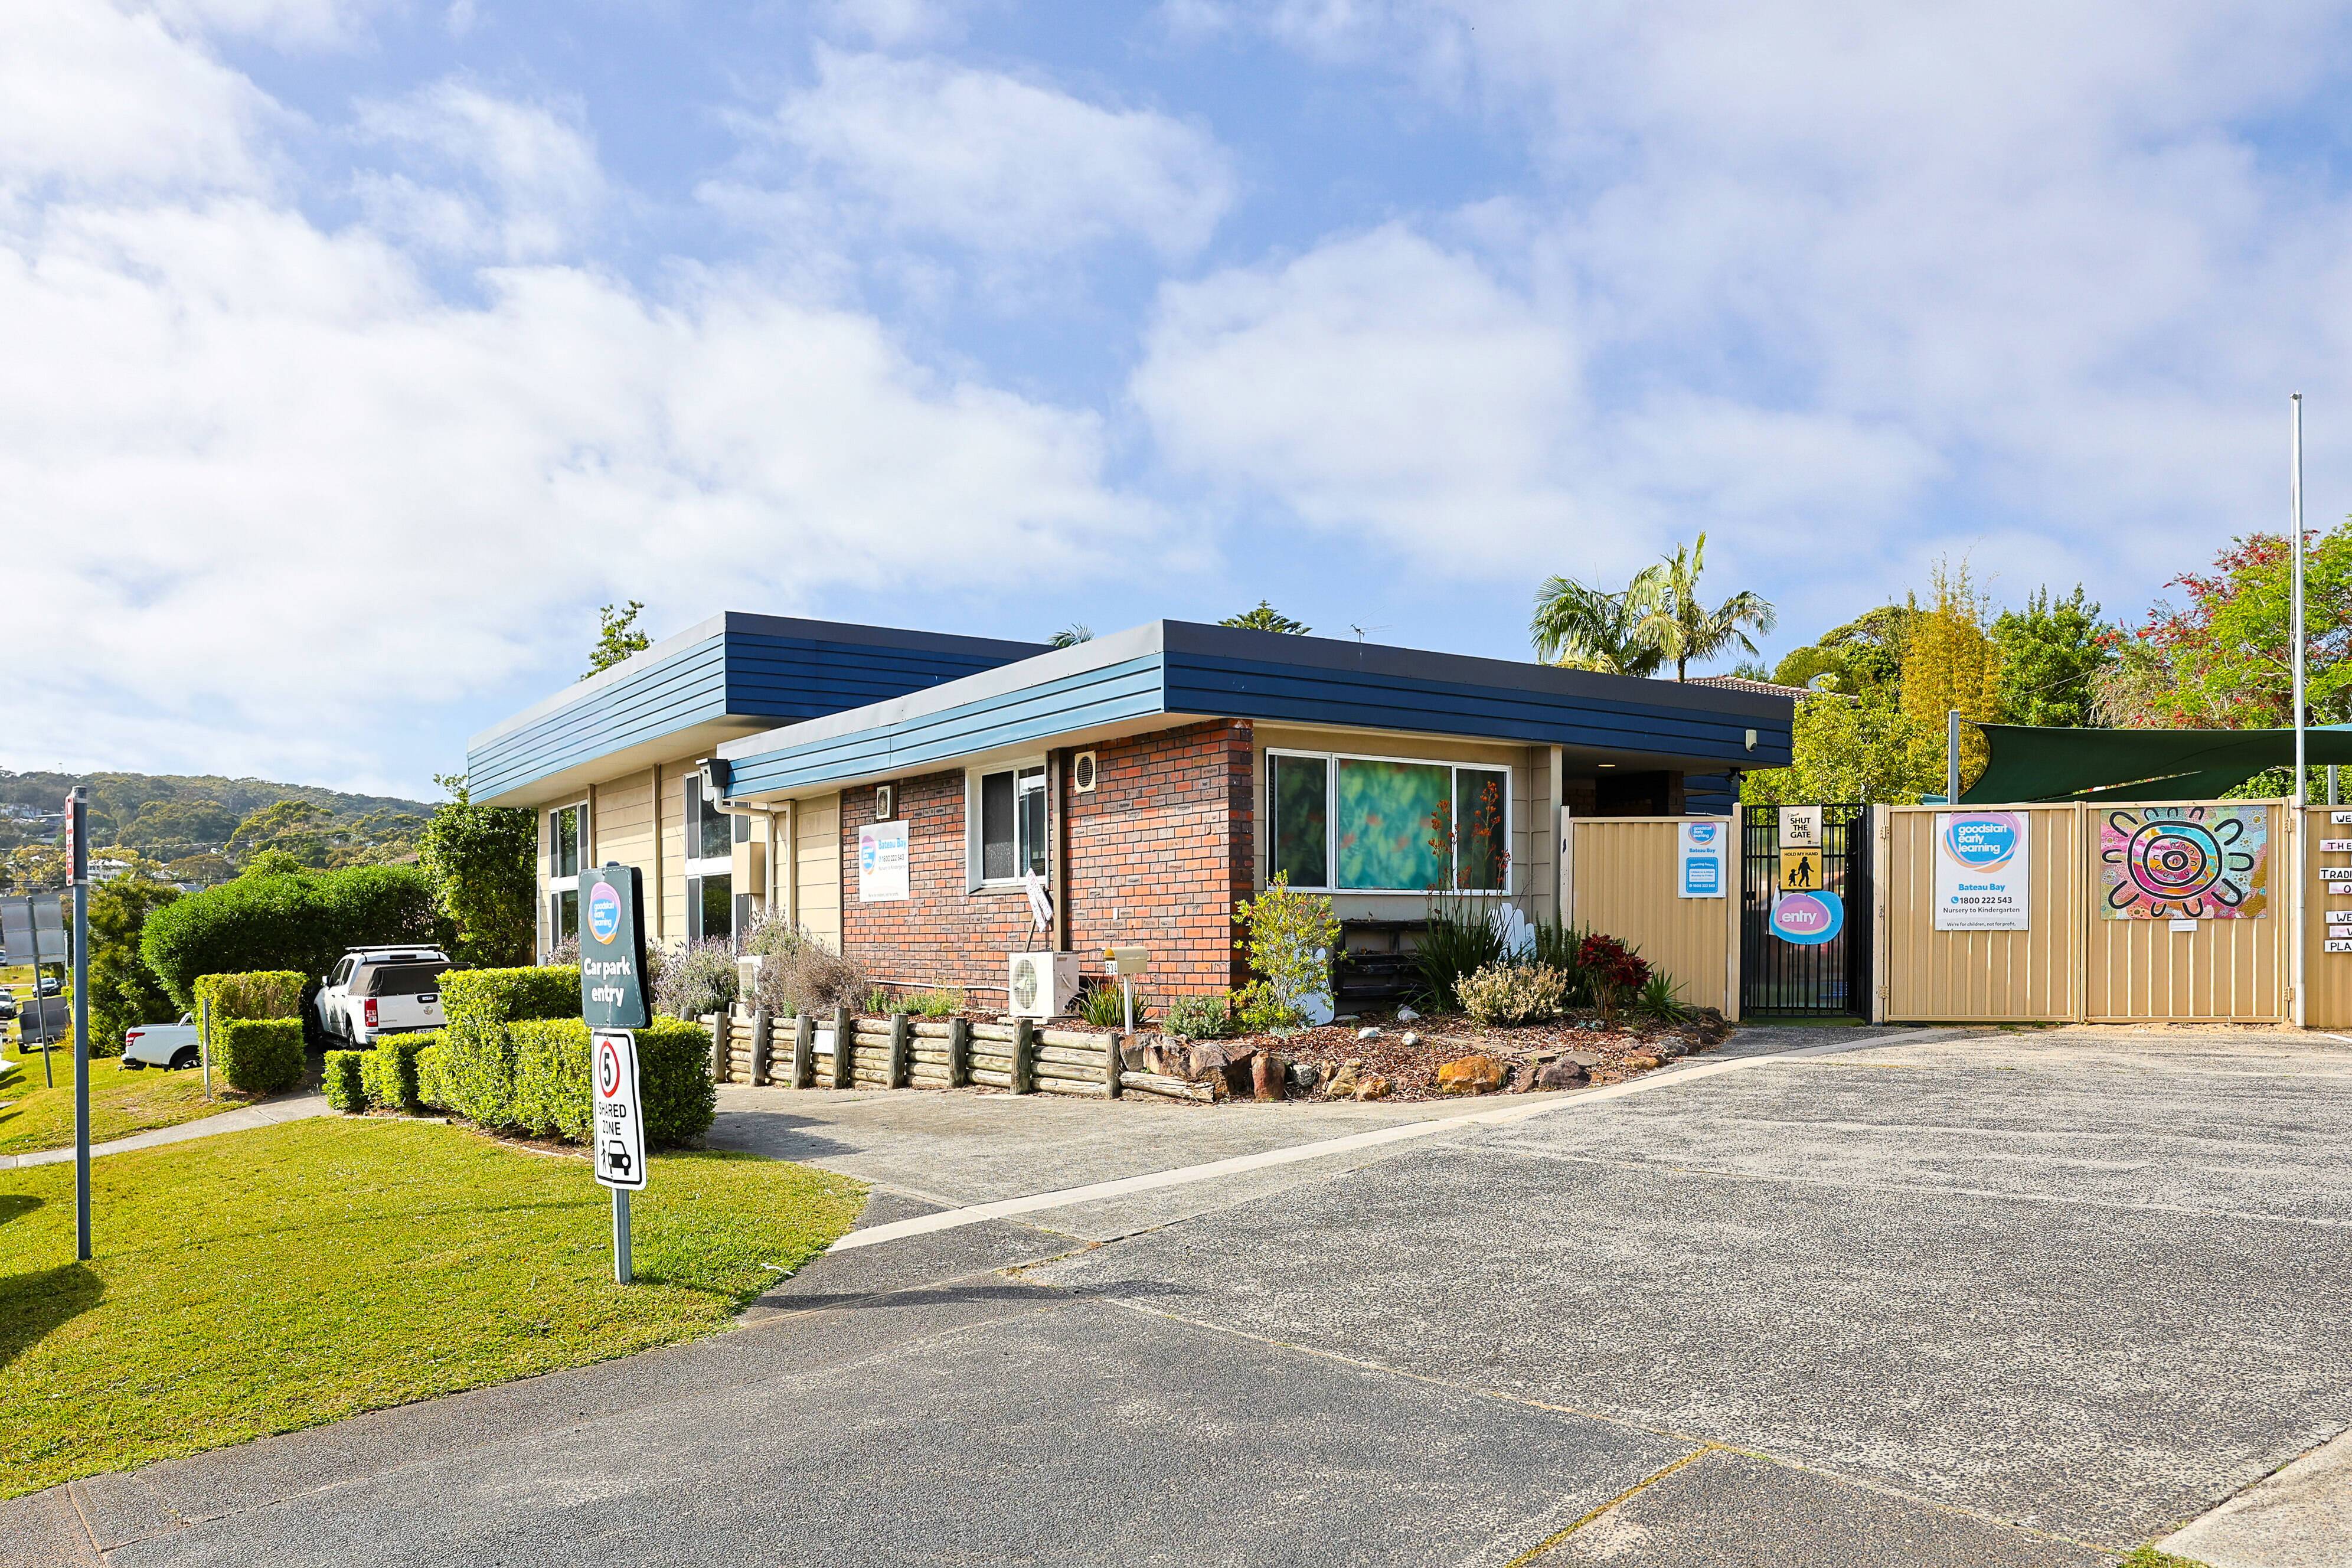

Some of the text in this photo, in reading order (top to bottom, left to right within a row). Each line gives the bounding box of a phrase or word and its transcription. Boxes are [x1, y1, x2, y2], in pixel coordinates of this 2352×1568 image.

[1958, 824, 2007, 835] goodstart
[878, 838, 906, 850] Bateau Bay
[1958, 834, 1984, 844] early
[1958, 844, 2000, 854] learning
[1990, 884, 2005, 892] Bay
[1782, 910, 1817, 925] entry
[584, 956, 631, 980] Car park
[1106, 963, 1117, 974] 534
[592, 984, 624, 1007] entry
[604, 1053, 610, 1087] 5
[599, 1102, 626, 1118] SHARED
[603, 1120, 621, 1135] ZONE
